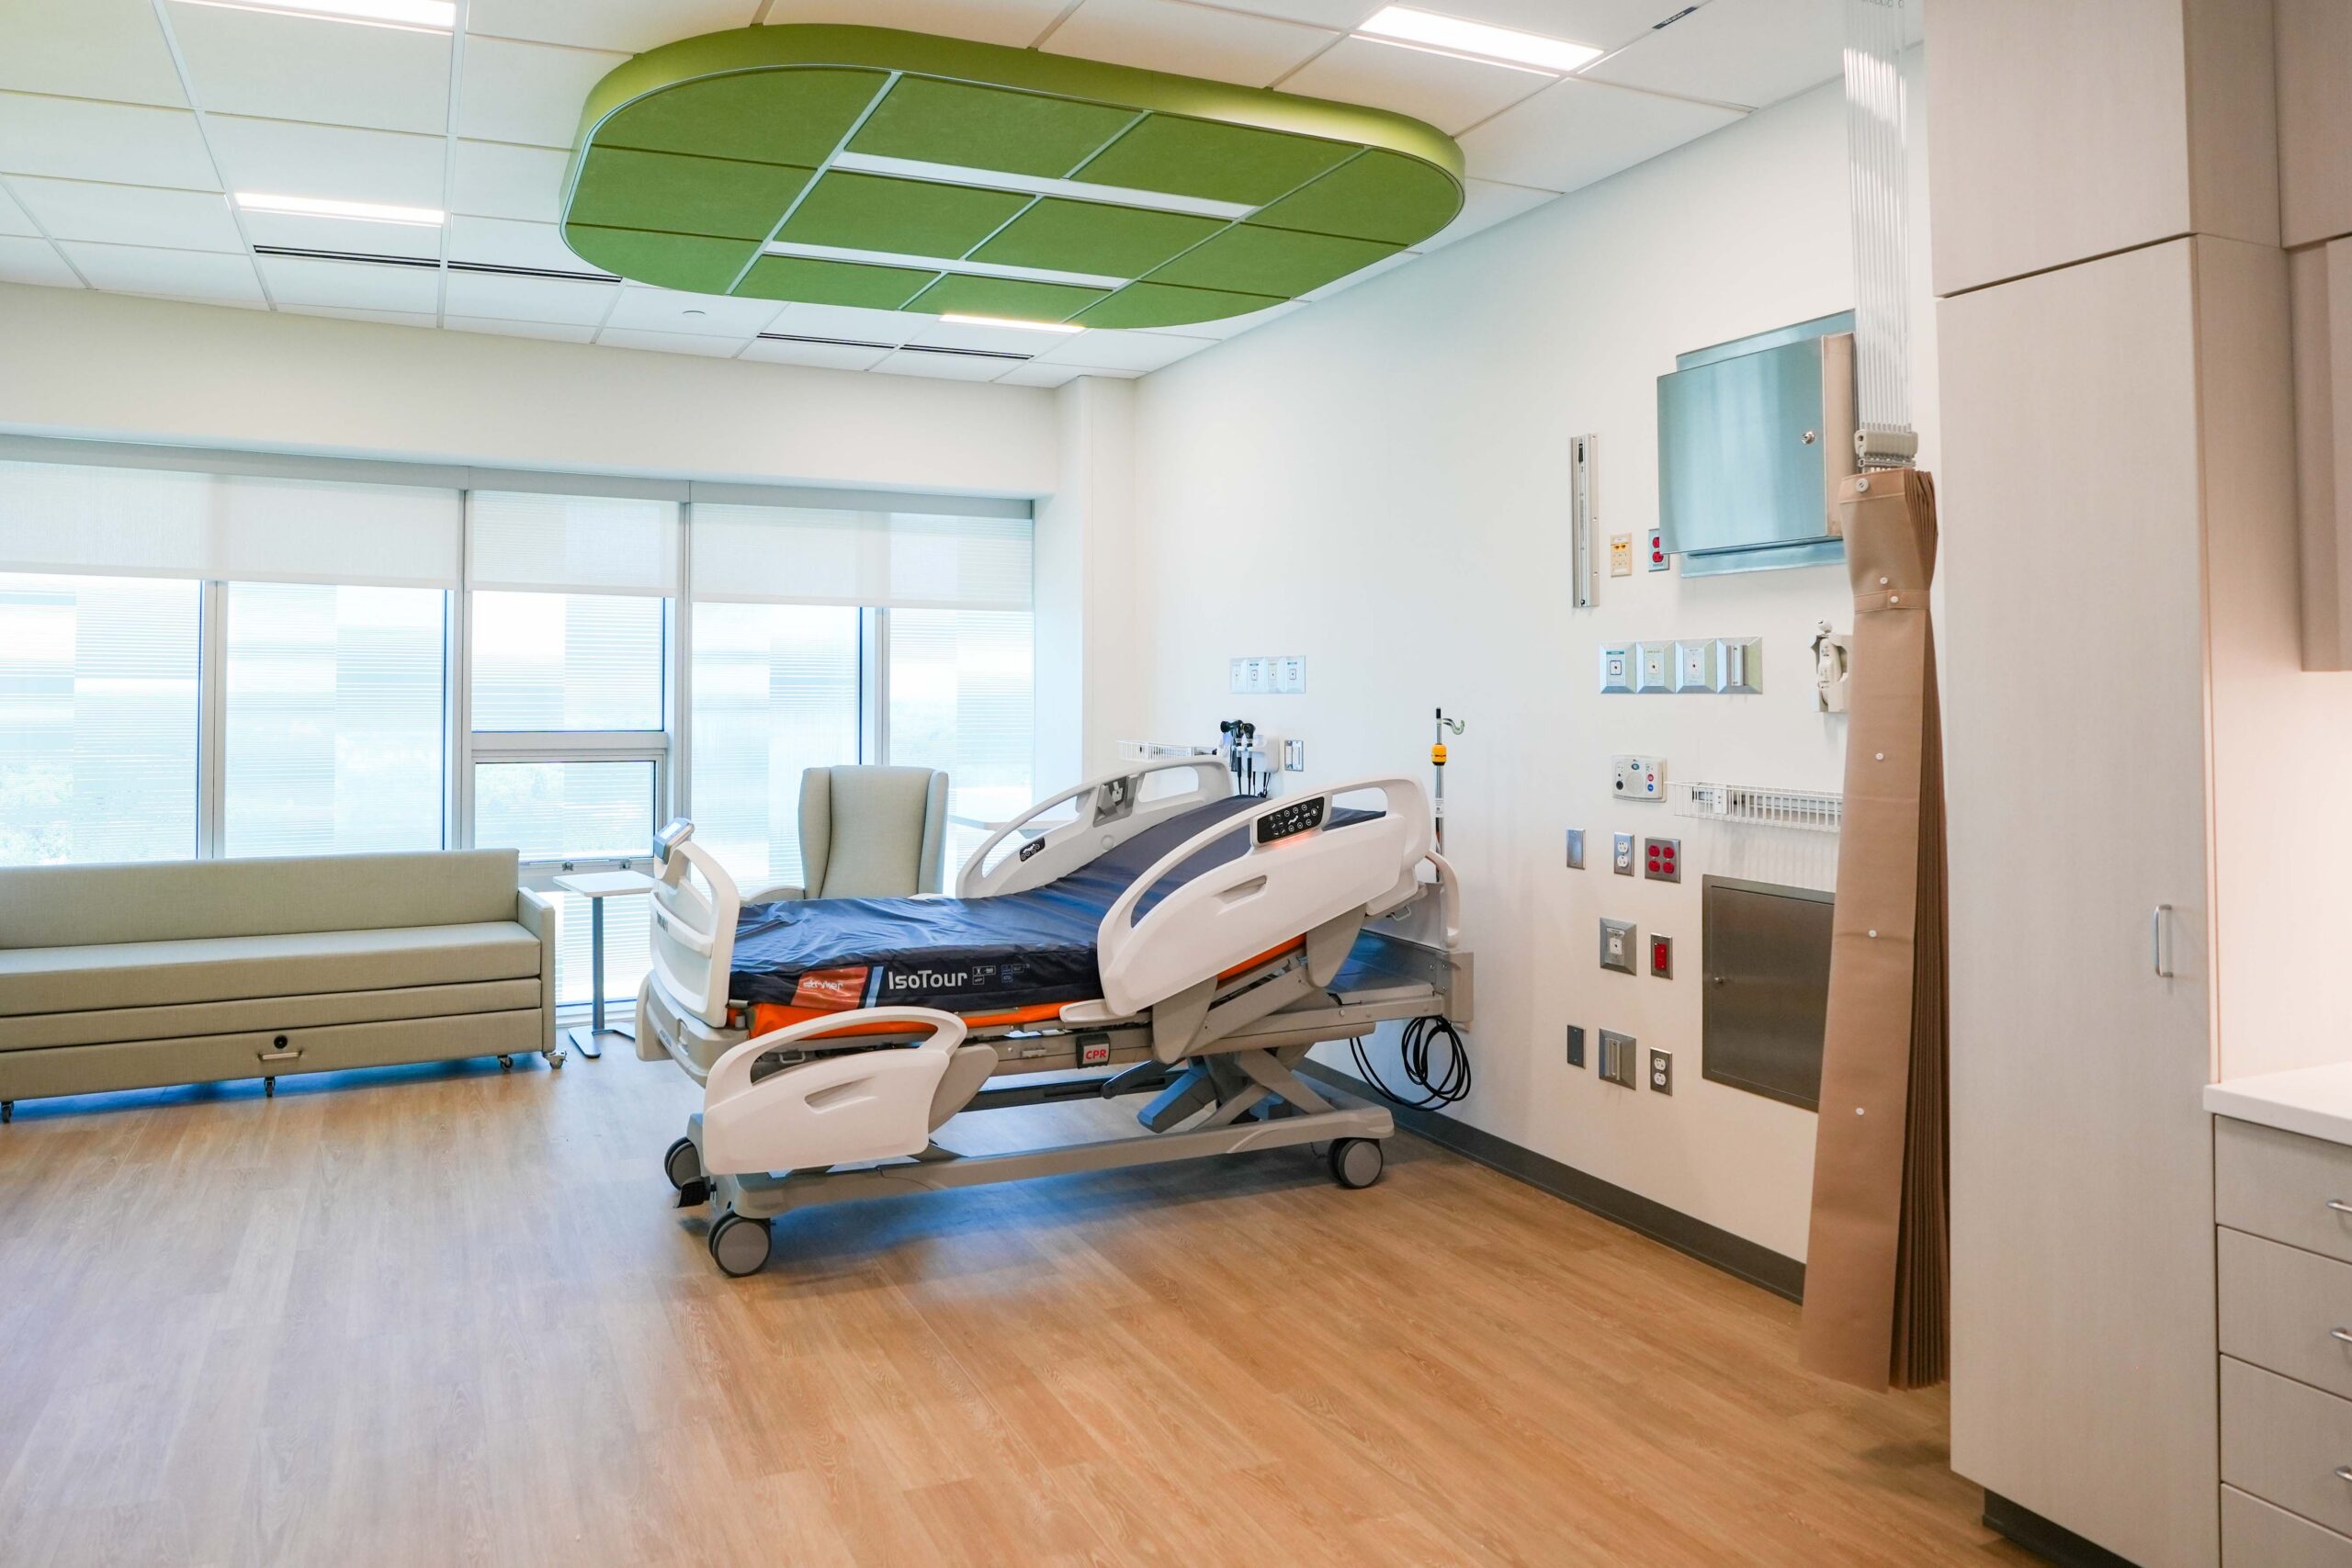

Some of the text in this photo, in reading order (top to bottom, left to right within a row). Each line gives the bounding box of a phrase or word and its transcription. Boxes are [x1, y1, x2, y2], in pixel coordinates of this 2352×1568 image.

[803, 978, 843, 991] stryker
[888, 970, 967, 989] IsoTour
[1085, 1048, 1107, 1060] CPR
